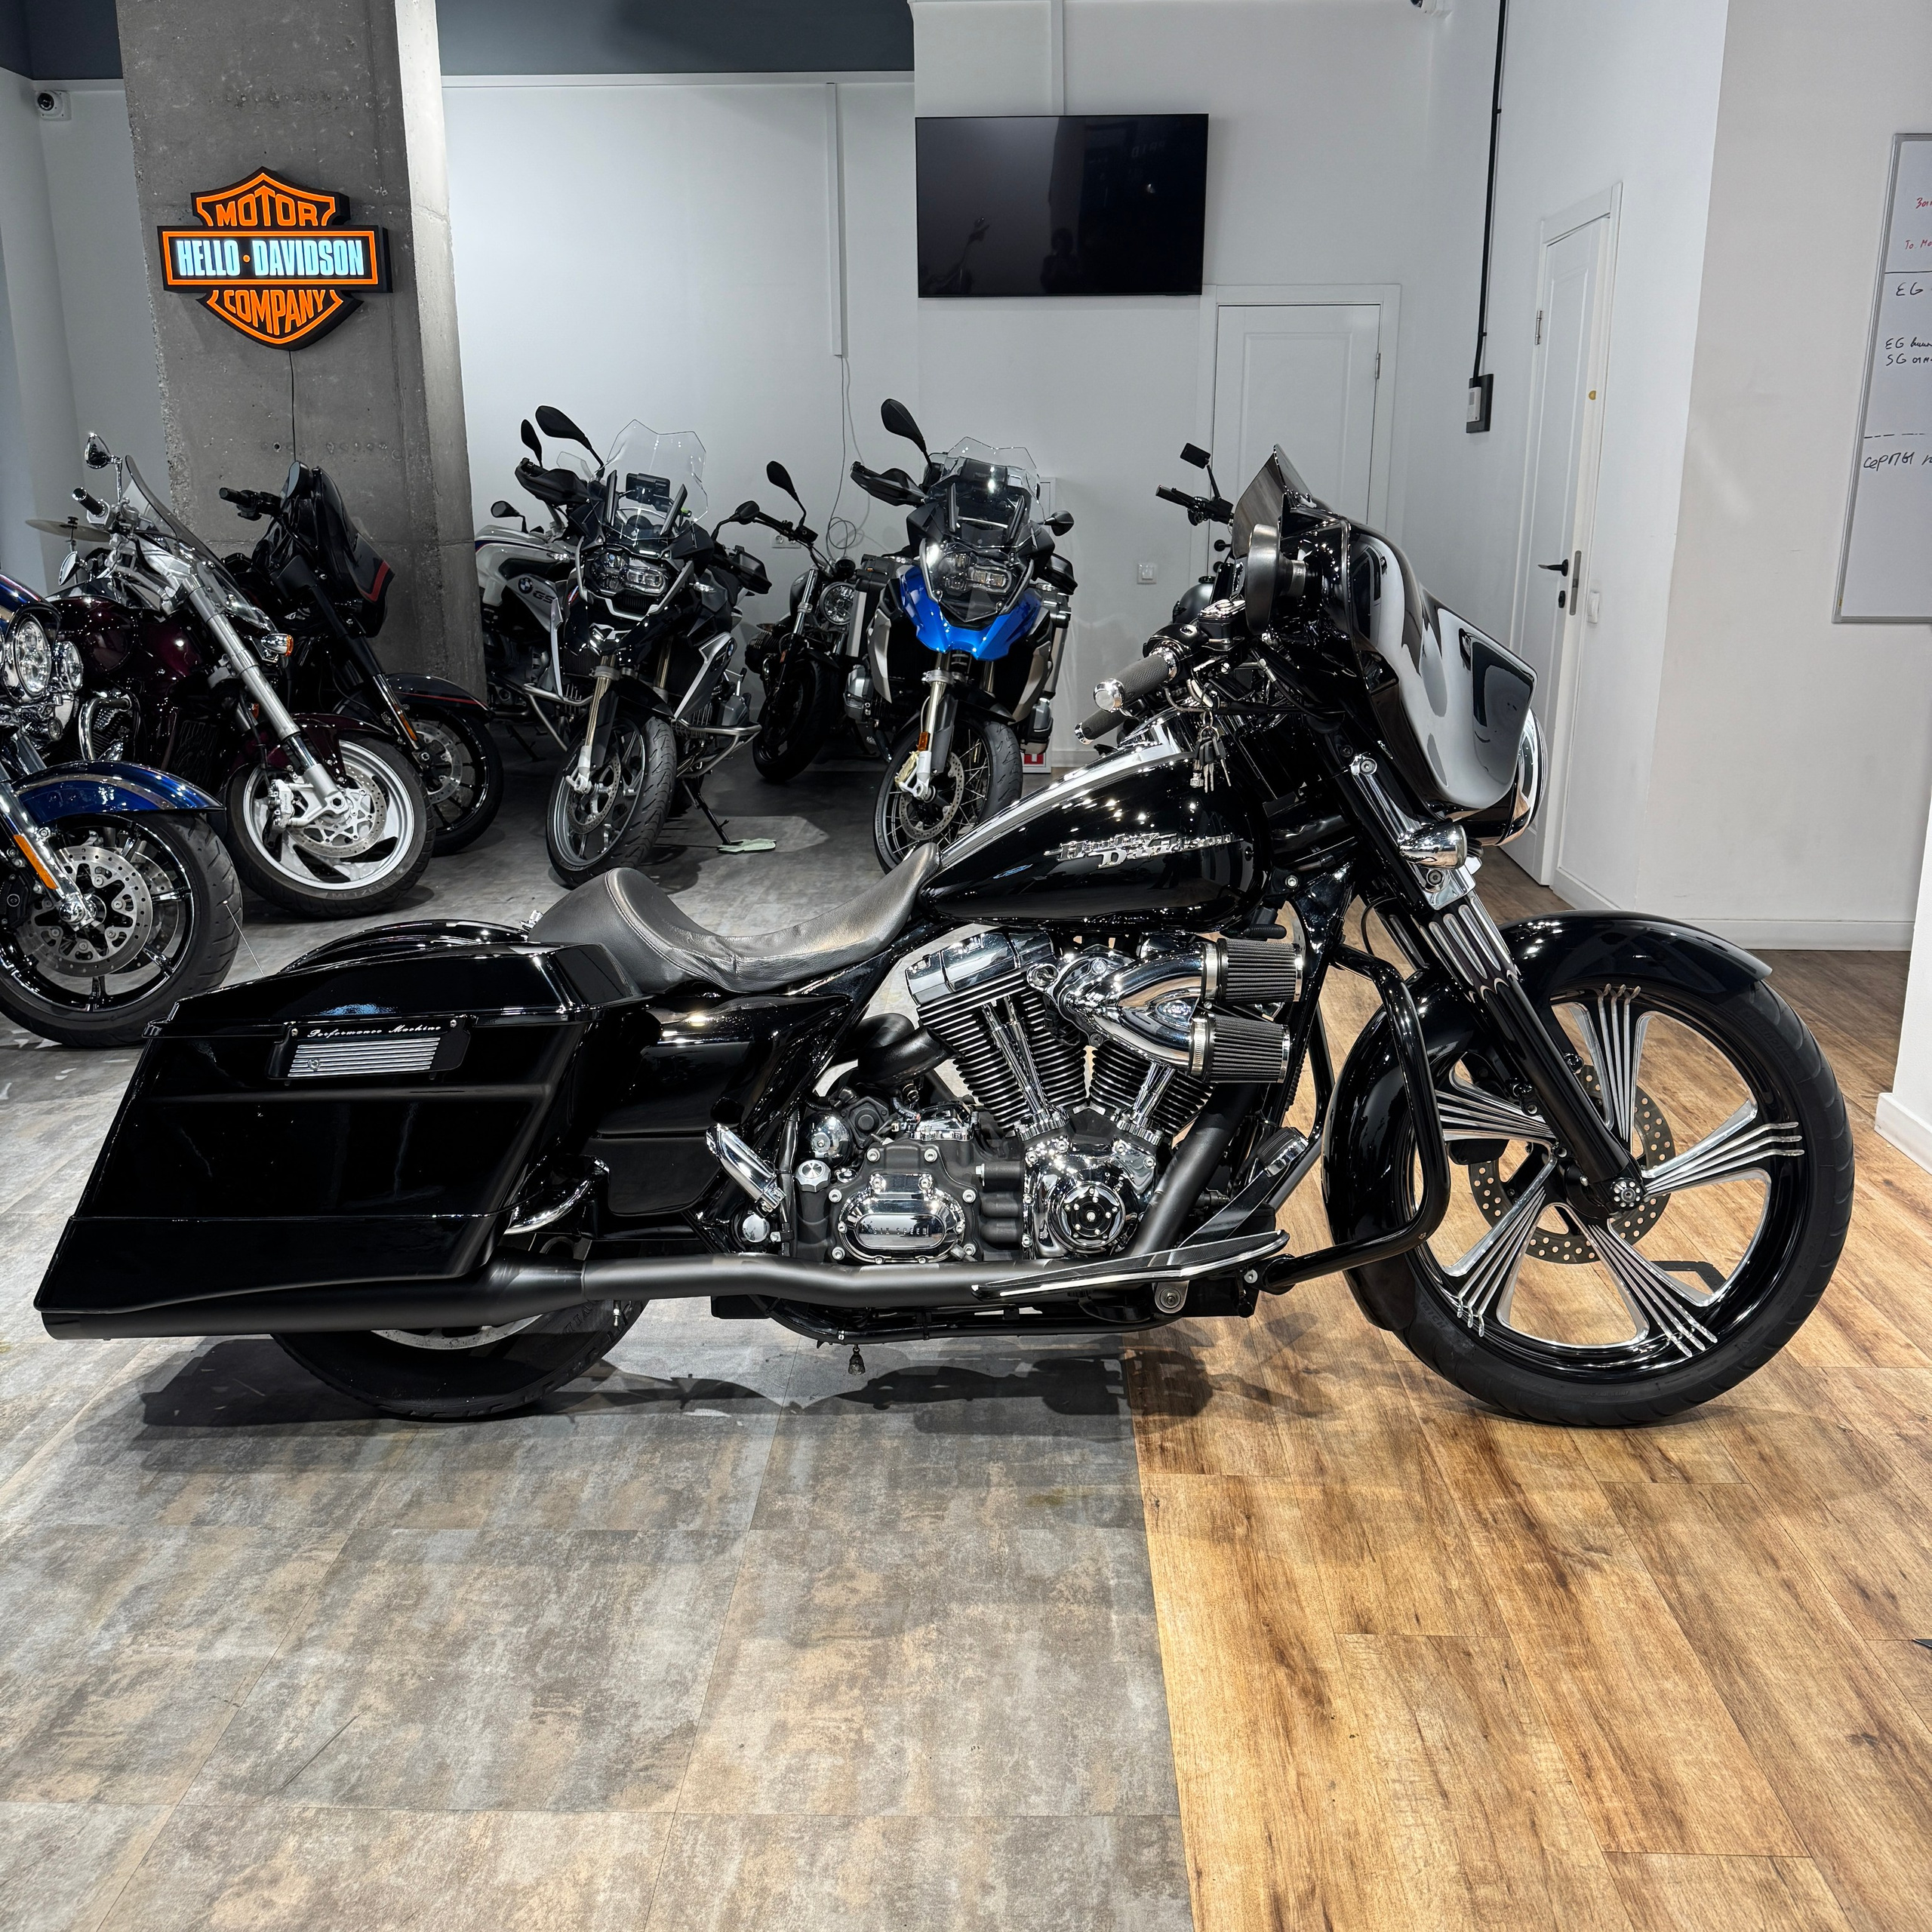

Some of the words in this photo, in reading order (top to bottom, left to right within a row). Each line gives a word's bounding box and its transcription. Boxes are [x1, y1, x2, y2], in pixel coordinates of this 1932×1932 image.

[215, 185, 318, 226] MOTOR
[176, 239, 241, 276] HELLO
[251, 239, 365, 276] DAVIDSON
[223, 289, 325, 336] COMPANY
[307, 1029, 383, 1038] Performance
[388, 1024, 441, 1034] Machine
